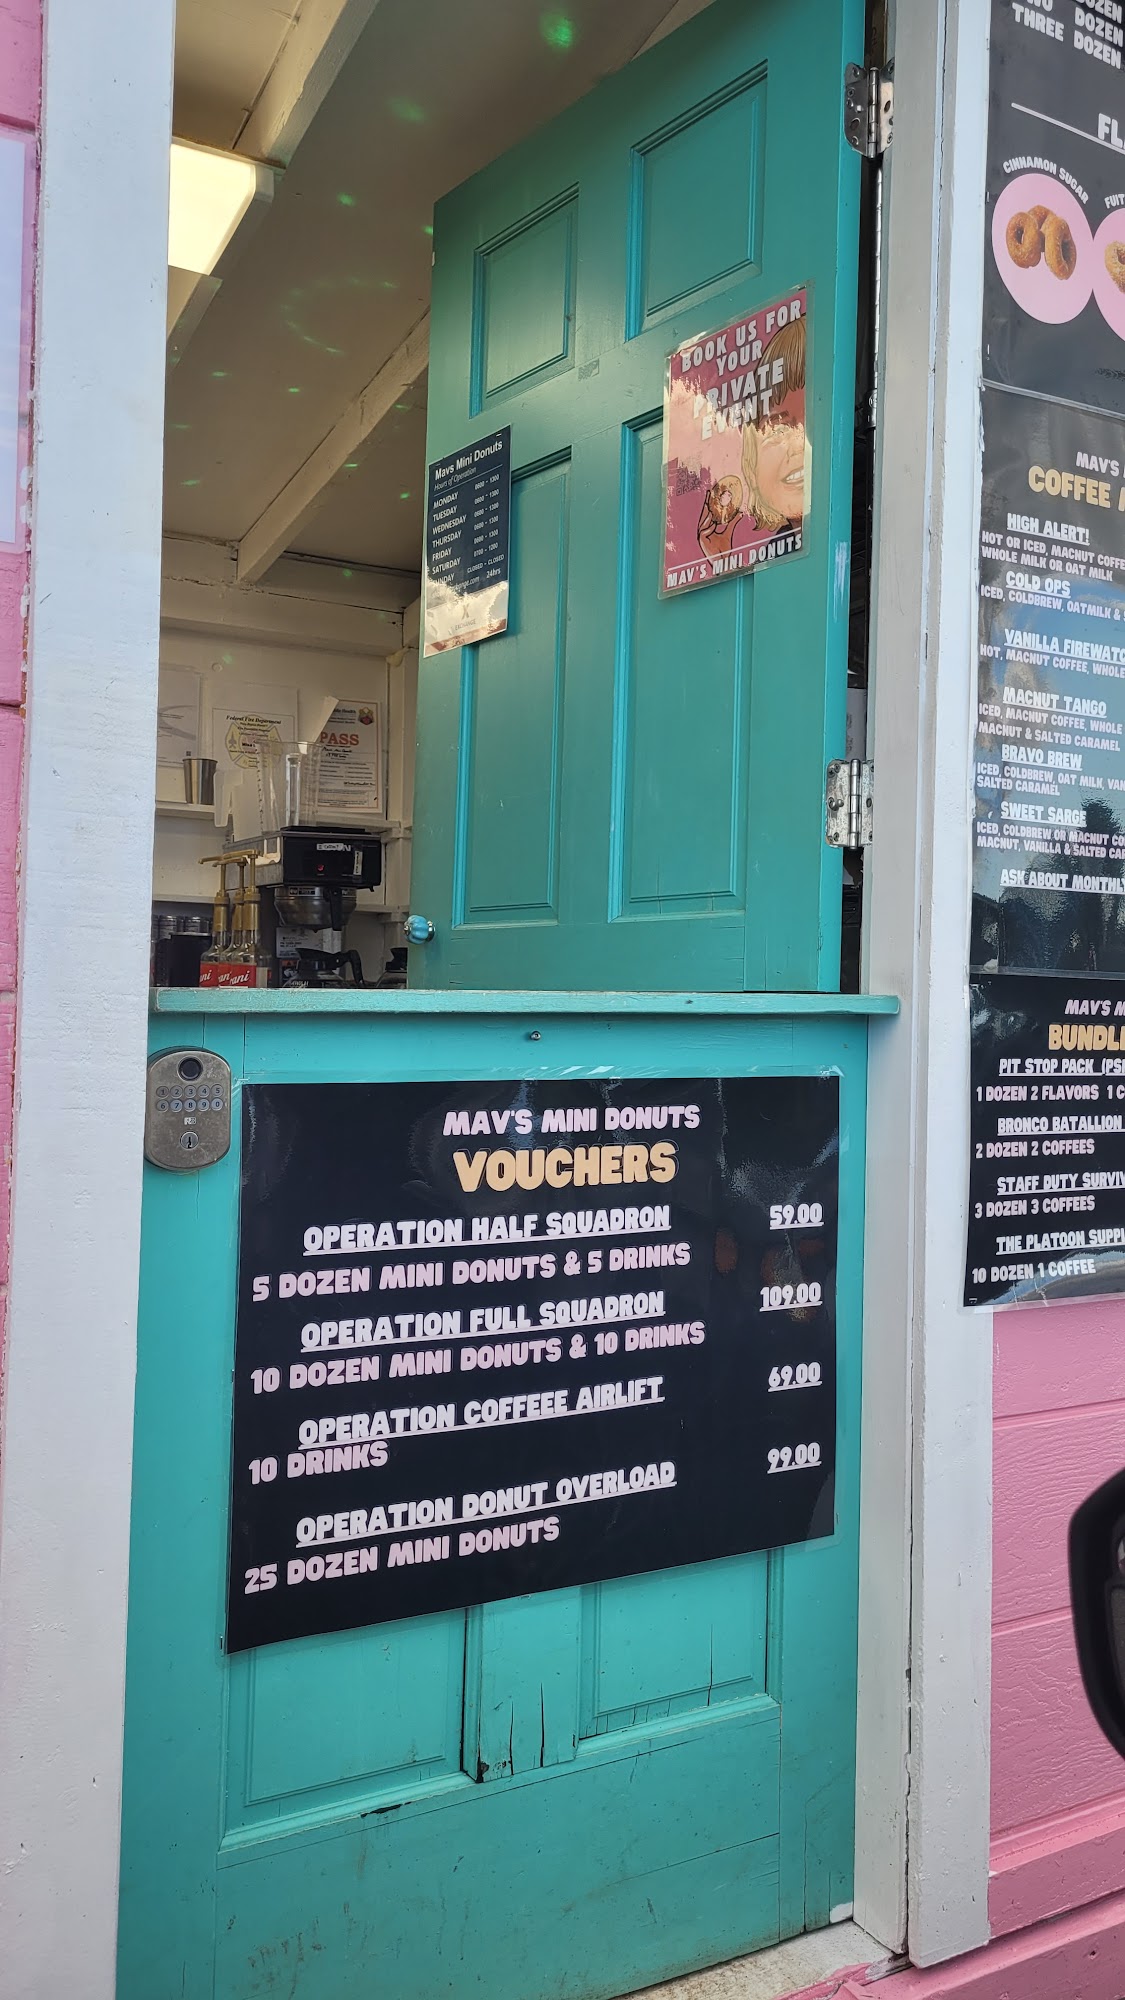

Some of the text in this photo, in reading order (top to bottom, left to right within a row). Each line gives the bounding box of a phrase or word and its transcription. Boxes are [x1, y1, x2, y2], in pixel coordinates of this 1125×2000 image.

[1012, 2, 1121, 69] THREE DOZEN
[1075, 7, 1123, 47] DOZEN
[1003, 156, 1089, 204] CINNAMON SUGAR
[681, 299, 801, 373] BOOK US FOR
[716, 340, 762, 376] YOUR
[694, 357, 784, 419] PRIVATE
[702, 389, 772, 441] EVENT
[435, 441, 503, 480] Mavs Mini Donuts
[1076, 452, 1119, 476] MAV'S
[434, 467, 476, 491] Hours Operation
[1028, 465, 1111, 508] COFFEE
[433, 491, 458, 509] MONDAY
[433, 505, 457, 521] TUESDAY
[432, 514, 467, 535] WEDNESDAY
[1007, 513, 1089, 543] HIGH ALERT!
[432, 530, 462, 548] THURSDAY
[982, 531, 1095, 563] HOT OR ICED, MACNUT
[432, 547, 452, 561] FRIDAY
[432, 557, 461, 575] SATURDAY
[466, 554, 504, 573] CLOSED CLOSED
[667, 534, 802, 588] MAV'S MINI DONUTS
[981, 546, 1113, 581] WHOLE MILK OR OAT MILK
[1006, 571, 1071, 596] COLD OPS
[981, 585, 1120, 621] ICED, COLDBREW, OATMILK &
[1004, 629, 1059, 653] VANILLA
[980, 644, 1089, 674] HOT, MACNUT COFFEE,
[1003, 687, 1106, 716] MACNUT TANGO
[979, 703, 1122, 735] ICED, MACNUT COFFEE, WHOLE
[320, 731, 359, 746] PASS
[979, 721, 1120, 751] MACNUT & SALTED CARAMEL
[1002, 744, 1082, 769] BRAVO BREW
[977, 763, 1077, 785] ICED, COLDBREW, OAT
[977, 775, 1060, 796] SALTED CARAMEL
[1001, 801, 1087, 825] SWEET SARGE
[977, 835, 1106, 858] MACNUT, VANILLA SALTED
[1054, 829, 1109, 845] OR MACNUT
[1000, 869, 1027, 886] ASK
[1029, 872, 1068, 888] ABOUT
[1065, 999, 1111, 1016] MAV'S
[1000, 1058, 1094, 1074] PIT STOP PACK
[976, 1085, 1113, 1101] 1 DOZEN 2 FLAVORS 1
[443, 1104, 700, 1136] MAV'S MINI DONUTS
[998, 1115, 1122, 1133] BRONCO BATALLION
[976, 1138, 1095, 1158] 2 DOZEN 2 COFFEES
[453, 1141, 676, 1193] VOUCHERS
[997, 1173, 1078, 1193] STAFF DUTY
[975, 1195, 1095, 1218] 3 DOZEN 3 COFFEES
[303, 1203, 823, 1252] OPERATION HALF SQUADRON 59.00
[996, 1231, 1085, 1253] THE PLATOON
[252, 1242, 691, 1302] 5 DOZEN MINI DONUTS & 5 DRINKS
[972, 1259, 1096, 1283] 10 DOZEN 1 COFFEE
[301, 1282, 821, 1348] OPERATION FULL SQUADRON 109.00
[250, 1321, 705, 1394] 10 DOZEN MINI DONUTS & 10 DRINKS
[298, 1361, 820, 1445] OPERATION COFFEEE AIRLIFT 69.00
[248, 1440, 388, 1485] 10 DRINKS
[296, 1441, 820, 1543] OPERATION DONUT OVERLOAD 99.00
[244, 1516, 560, 1594] 25 DOZEN MINI DONUTS
